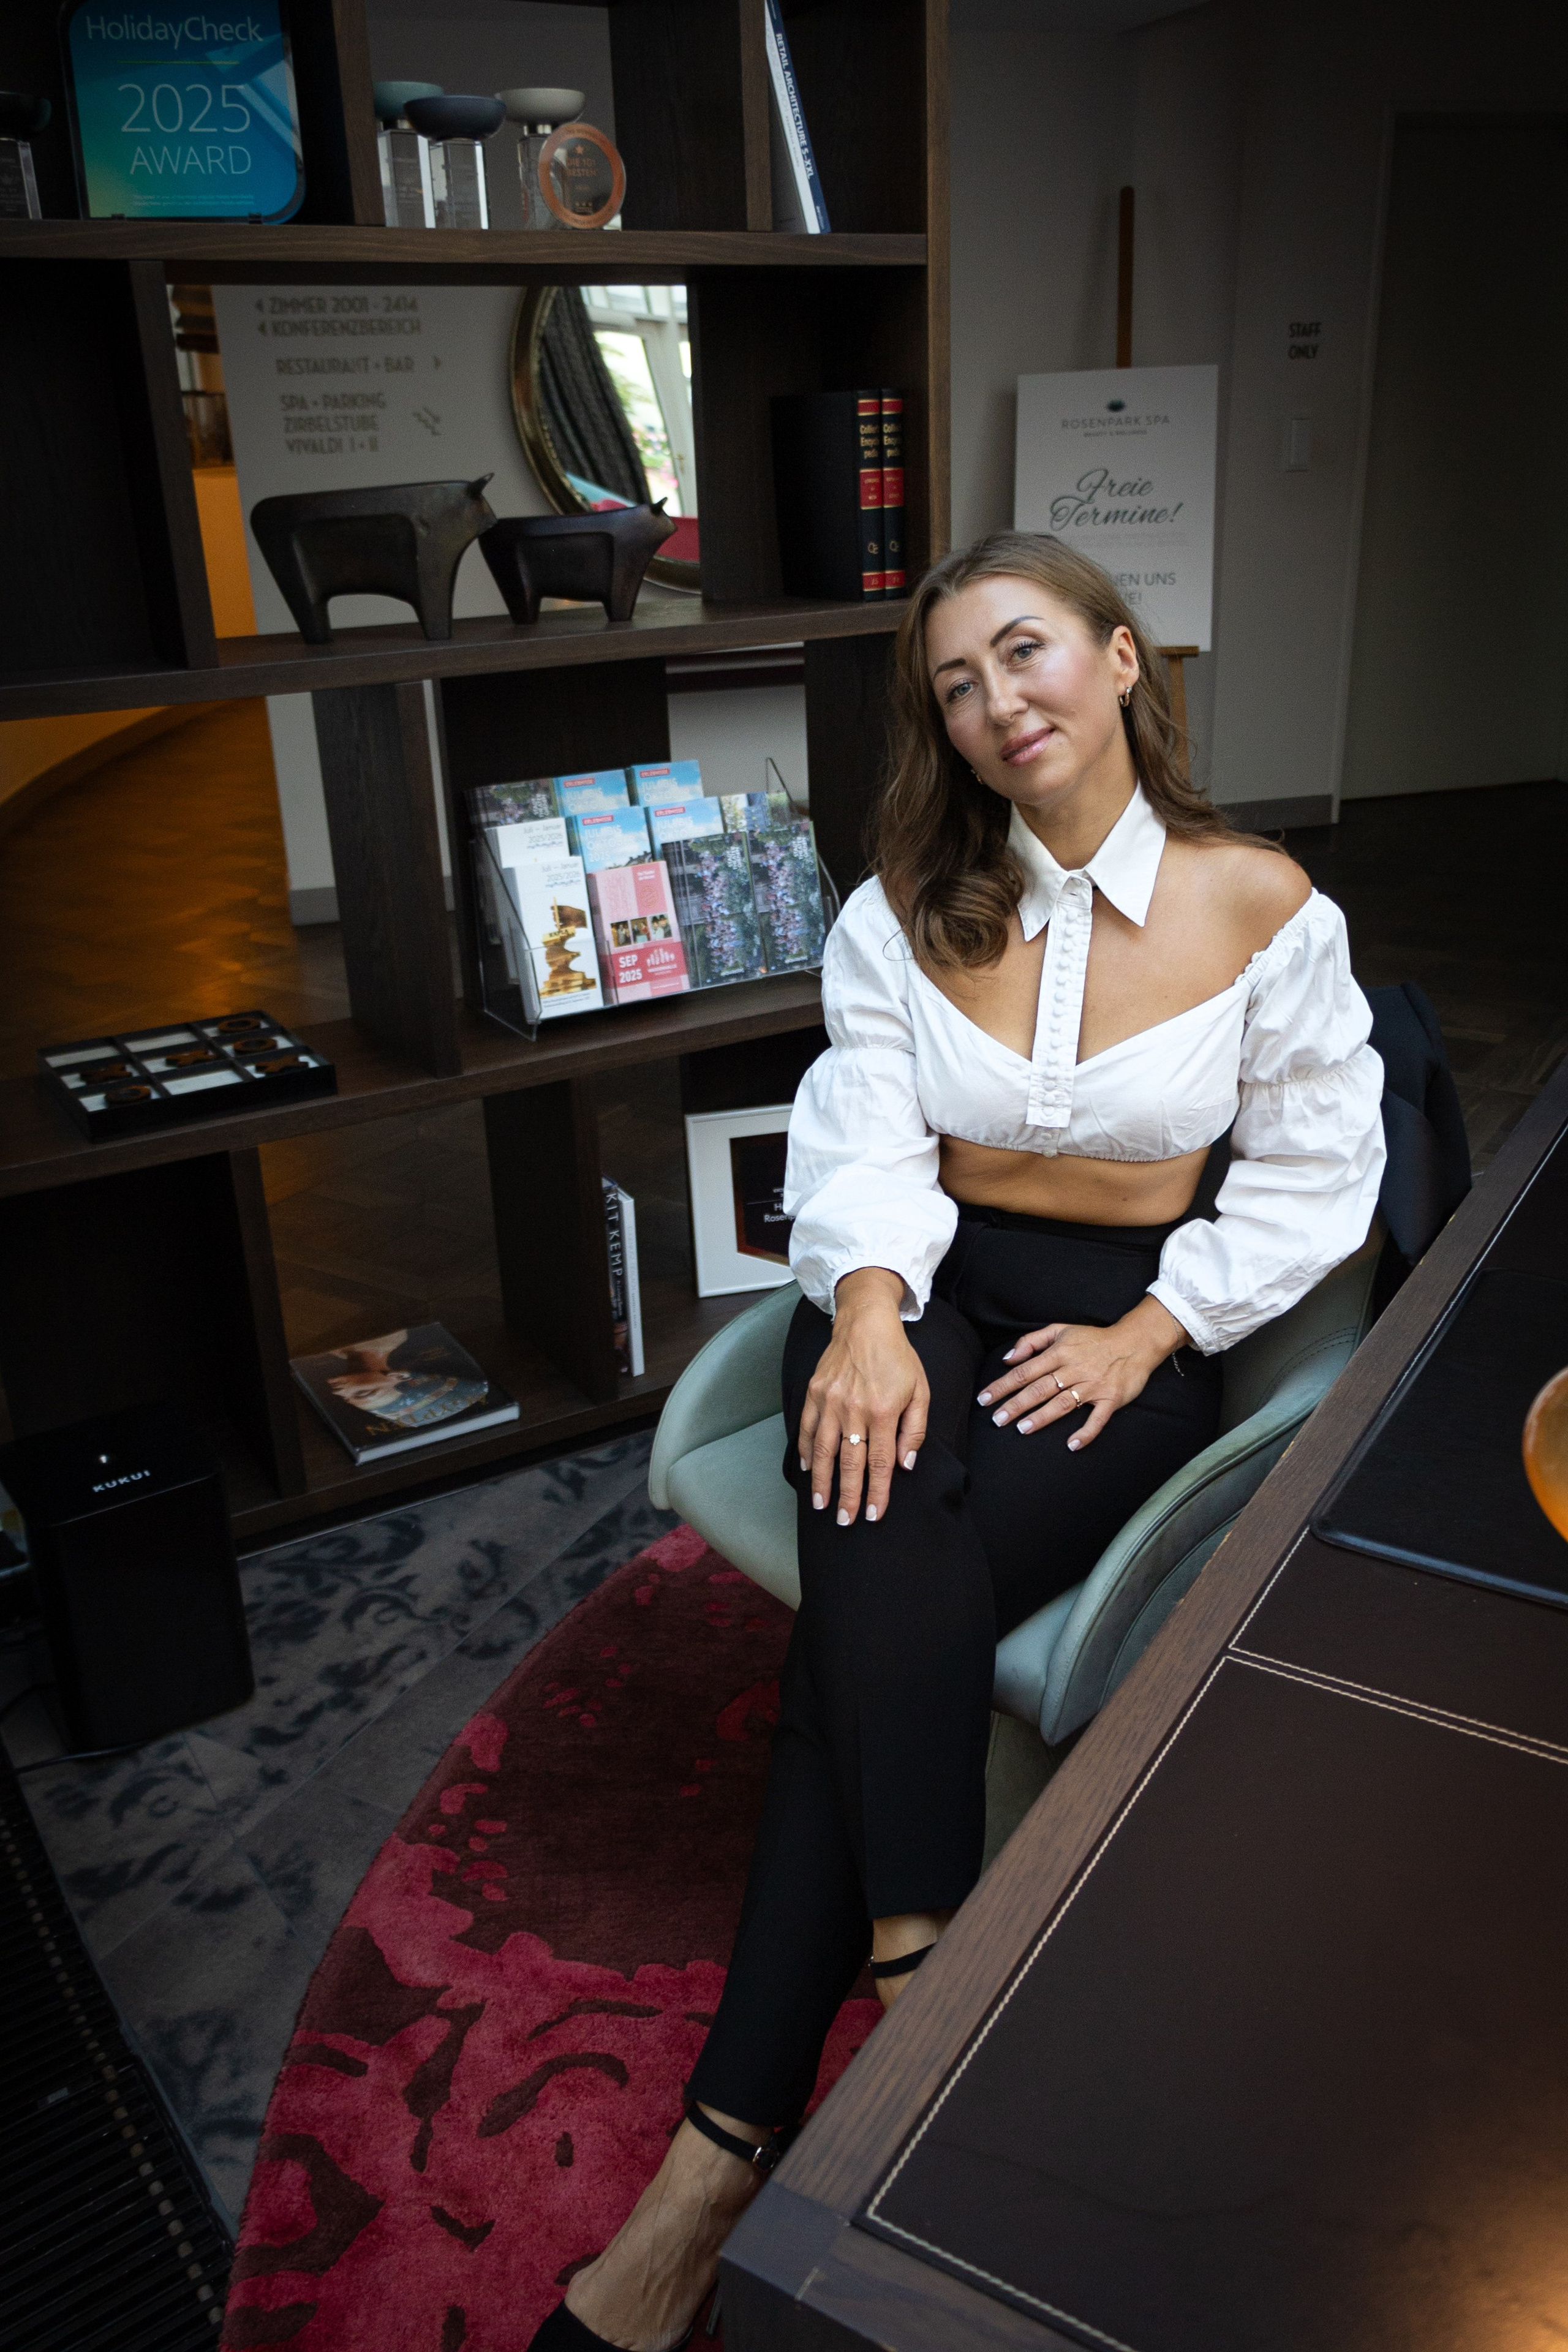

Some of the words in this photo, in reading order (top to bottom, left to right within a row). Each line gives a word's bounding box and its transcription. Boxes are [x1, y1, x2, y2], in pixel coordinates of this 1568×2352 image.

[86, 15, 263, 50] HolidayCheck
[775, 33, 789, 69] RETAIL
[783, 70, 807, 146] ARCHITECTURE
[118, 84, 251, 133] 2025
[130, 146, 252, 175] AWARD
[269, 297, 326, 315] ZIMMER
[271, 318, 422, 337] KONFERENZBEREICH
[1289, 323, 1321, 337] STAFF
[1288, 345, 1318, 360] ONLY
[276, 357, 369, 375] RESTAURANT
[385, 356, 415, 373] BAR
[280, 394, 308, 412] SPA
[323, 393, 386, 409] PARKING
[283, 415, 379, 433] ZIRBELSTUBE
[1061, 417, 1140, 429] ROSENPARK
[1146, 415, 1170, 426] SPA
[285, 436, 344, 454] VIVALDI
[1077, 469, 1154, 503] Freie
[1050, 495, 1184, 532] Termine!
[1145, 572, 1176, 585] UNS
[619, 955, 638, 968] SEP
[619, 969, 643, 984] 2025
[605, 1193, 619, 1221] KIT
[608, 1229, 623, 1276] KEMP
[91, 1469, 152, 1493] KUKUI
